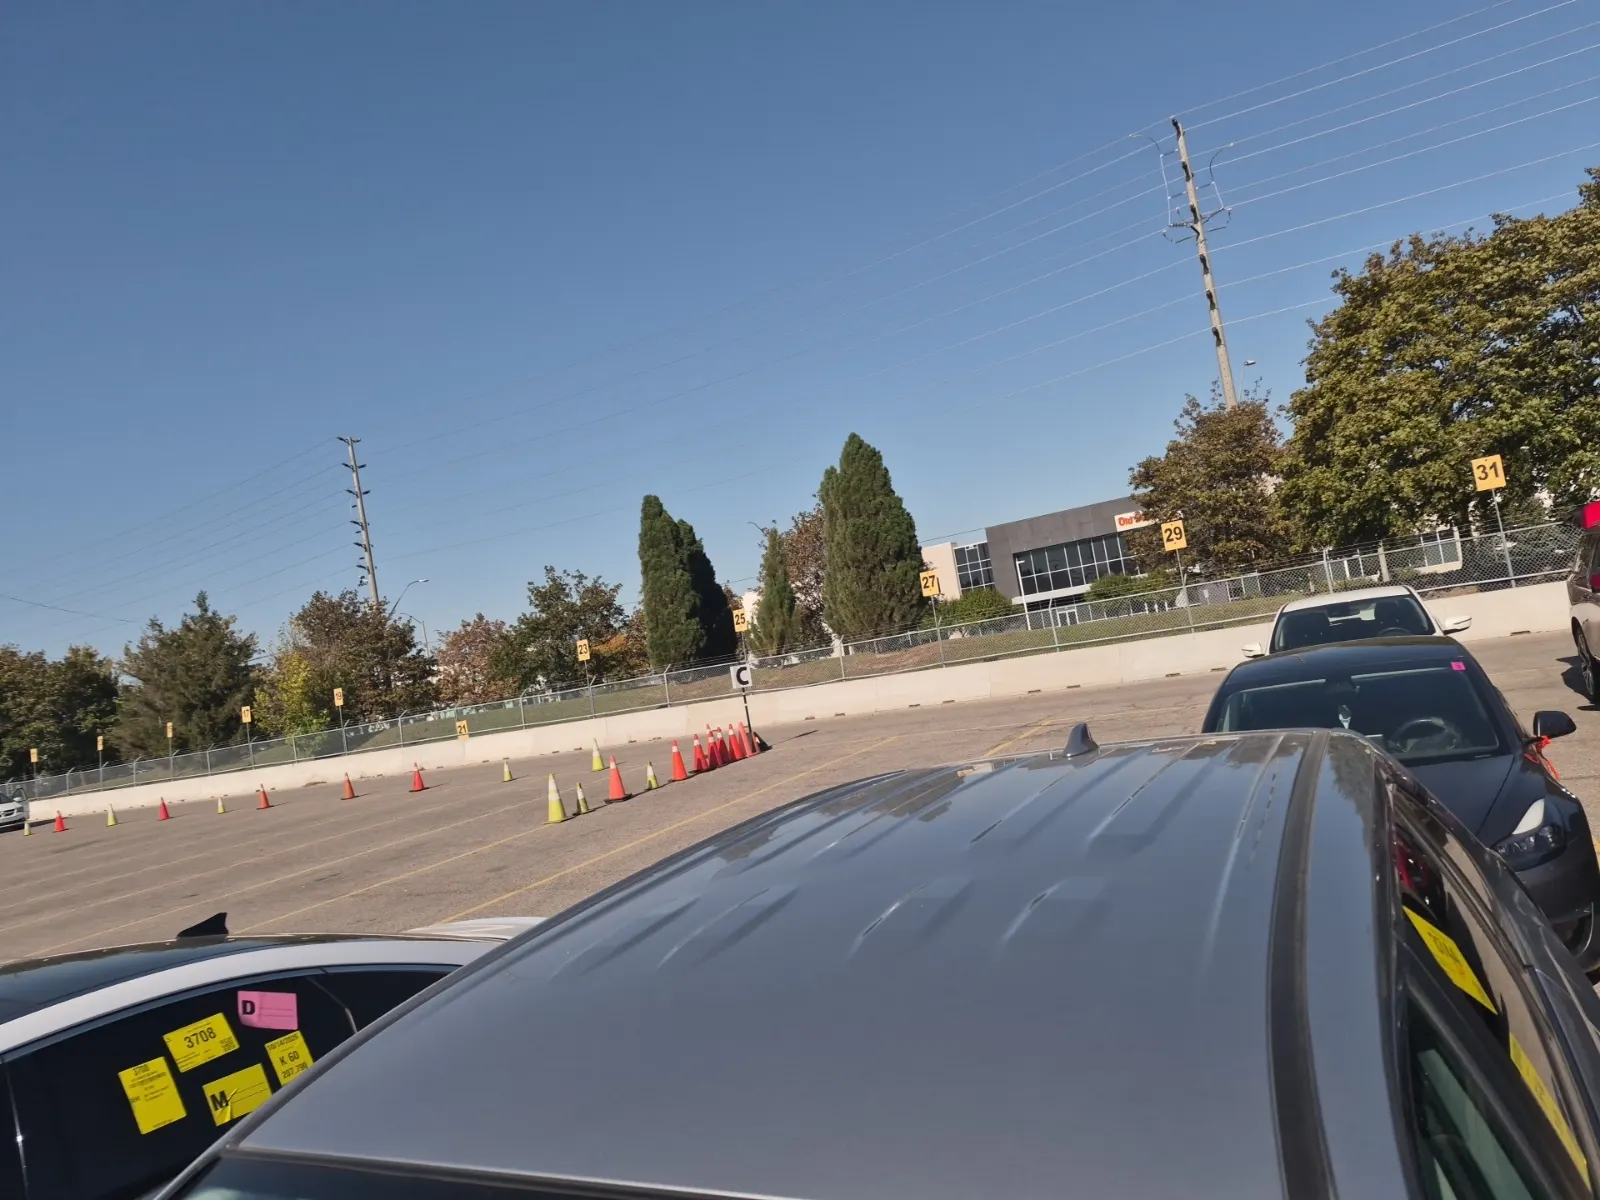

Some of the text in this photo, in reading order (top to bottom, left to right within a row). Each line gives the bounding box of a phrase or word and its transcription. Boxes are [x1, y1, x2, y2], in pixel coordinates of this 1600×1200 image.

[1476, 461, 1499, 481] 31
[1164, 526, 1183, 543] 29
[922, 574, 936, 589] 27
[734, 613, 746, 626] 25
[578, 643, 588, 655] 23
[736, 666, 749, 686] C
[457, 723, 467, 734] 21
[241, 1000, 255, 1016] D
[183, 1027, 217, 1049] 3708
[278, 1050, 300, 1066] K 60
[209, 1090, 230, 1111] M
